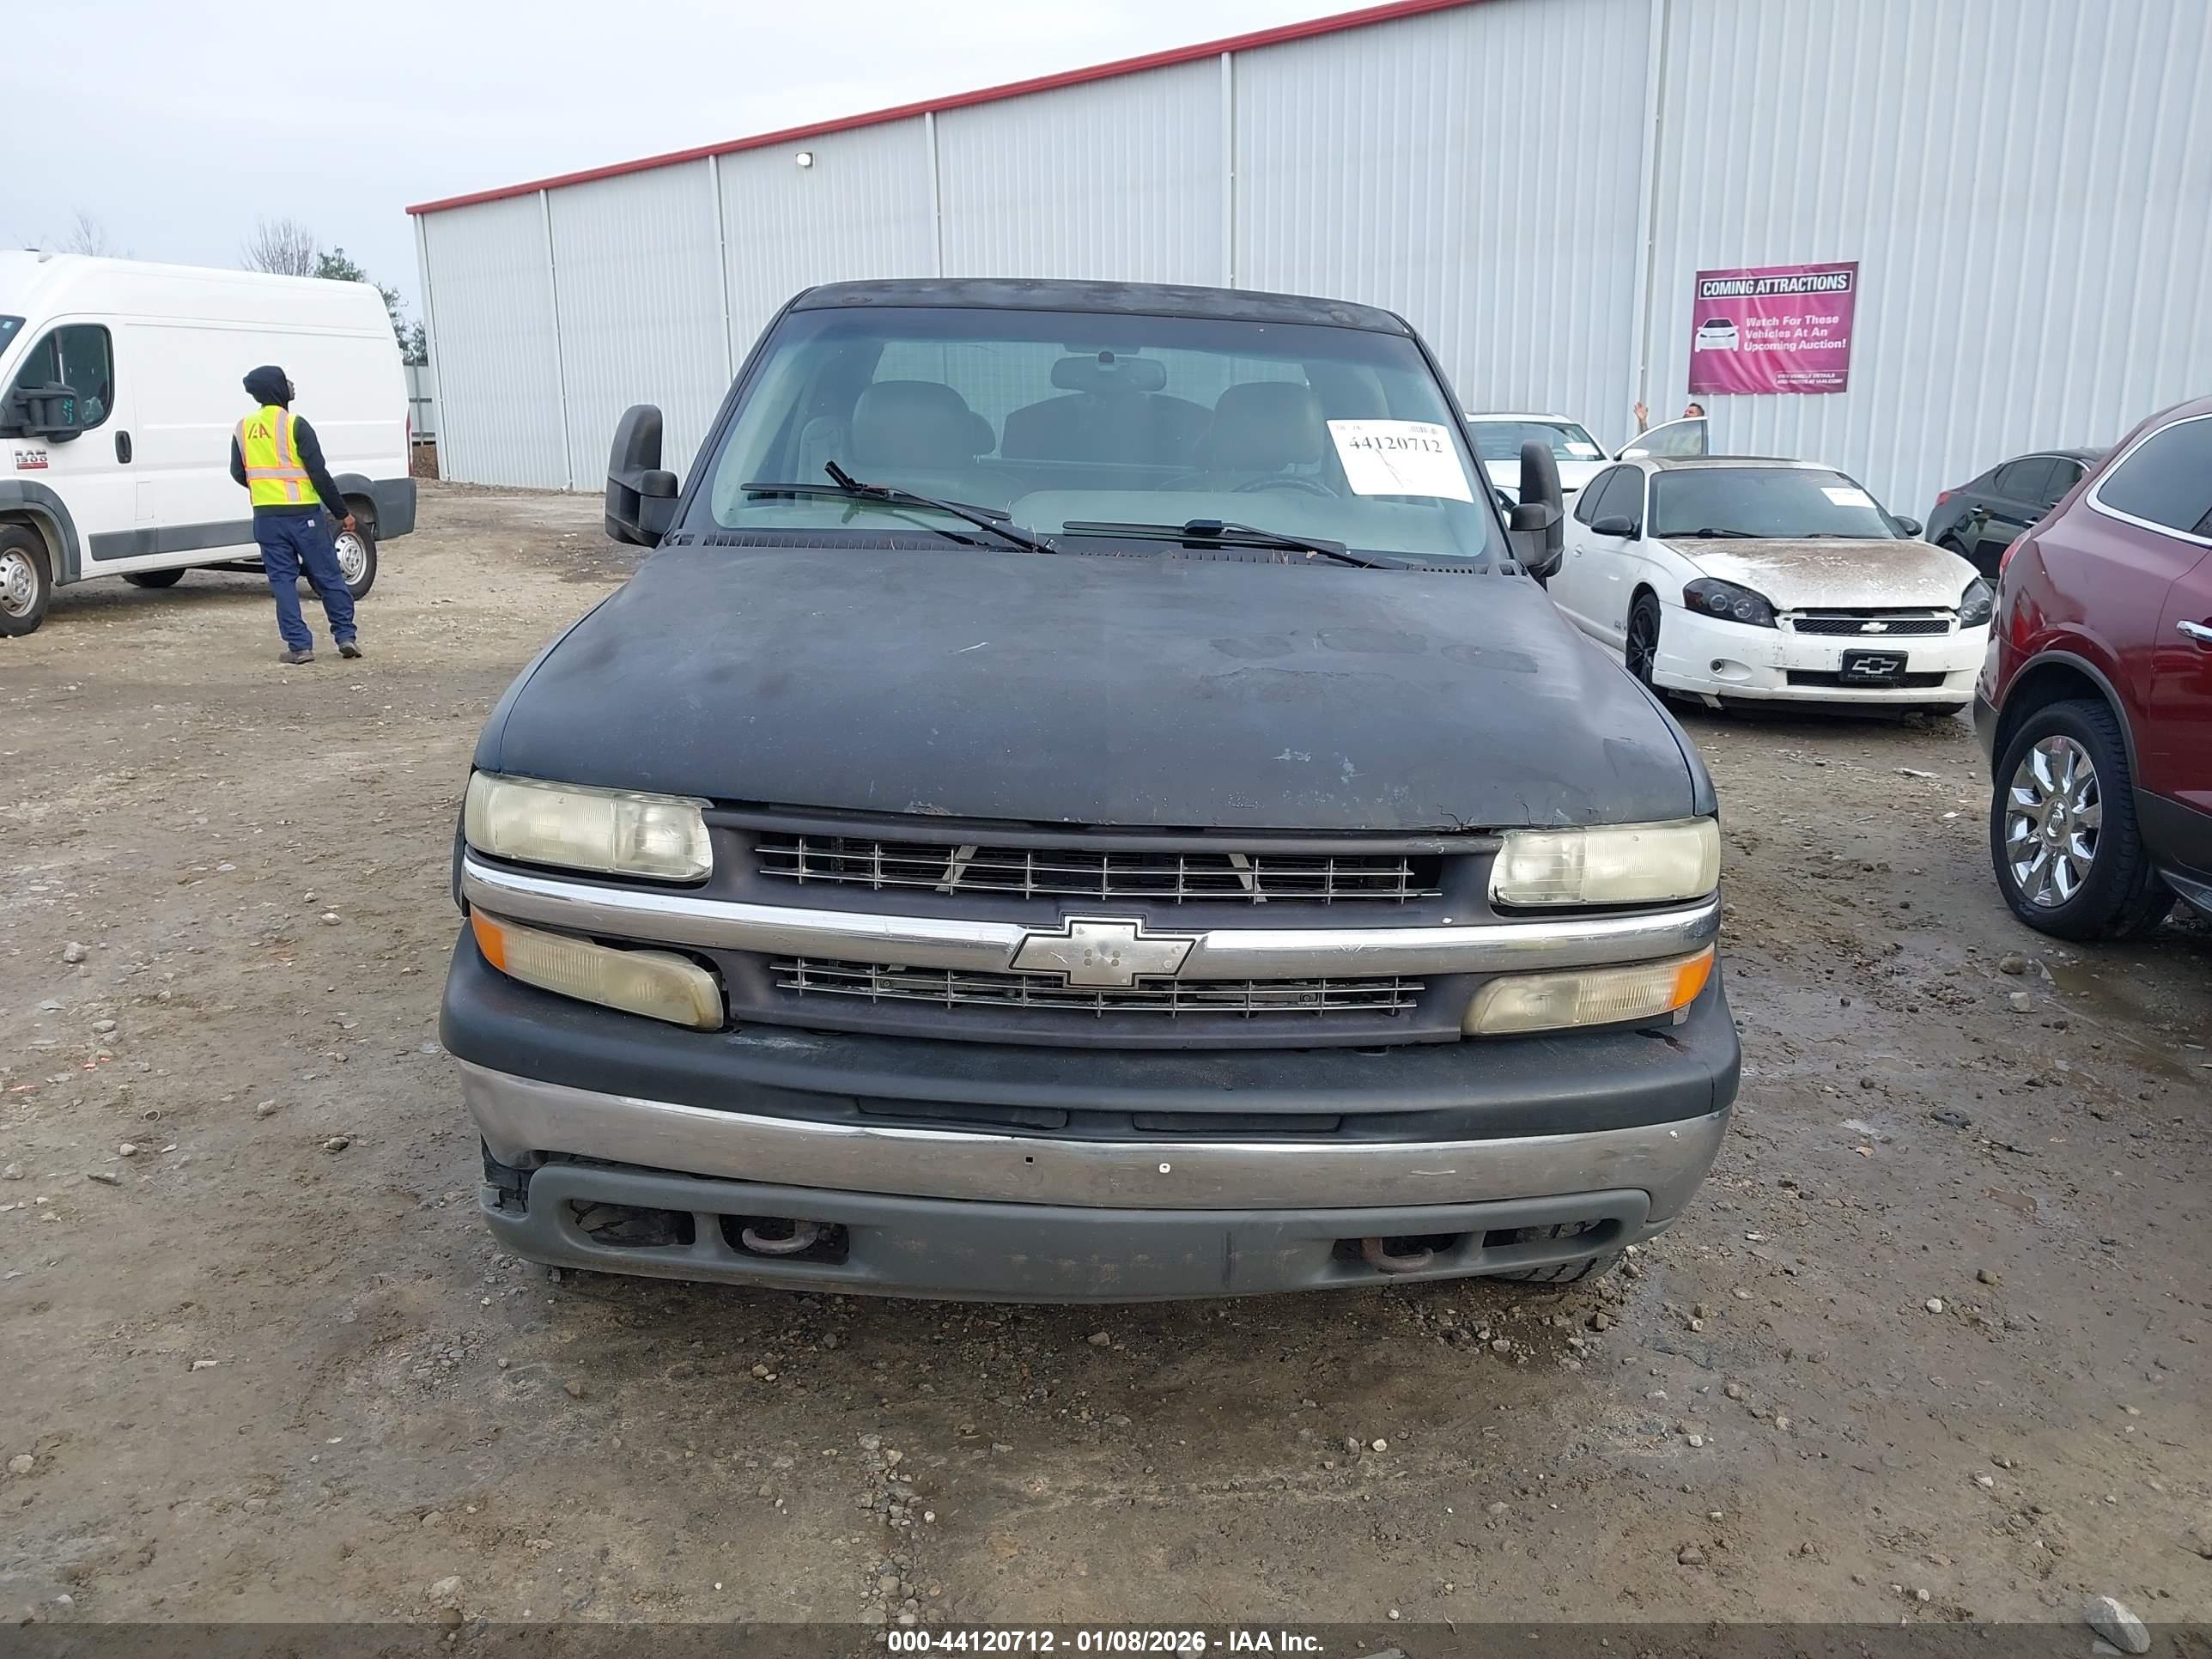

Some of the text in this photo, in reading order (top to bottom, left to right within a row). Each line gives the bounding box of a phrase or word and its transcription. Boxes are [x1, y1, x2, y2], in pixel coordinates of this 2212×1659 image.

[1703, 275, 1848, 296] COMING ATTRACTIONS
[1746, 315, 1839, 327] Watch For These
[1745, 327, 1828, 338] Vehicles At An
[1744, 338, 1847, 352] Upcoming Auction!
[1349, 436, 1443, 453] 44120712
